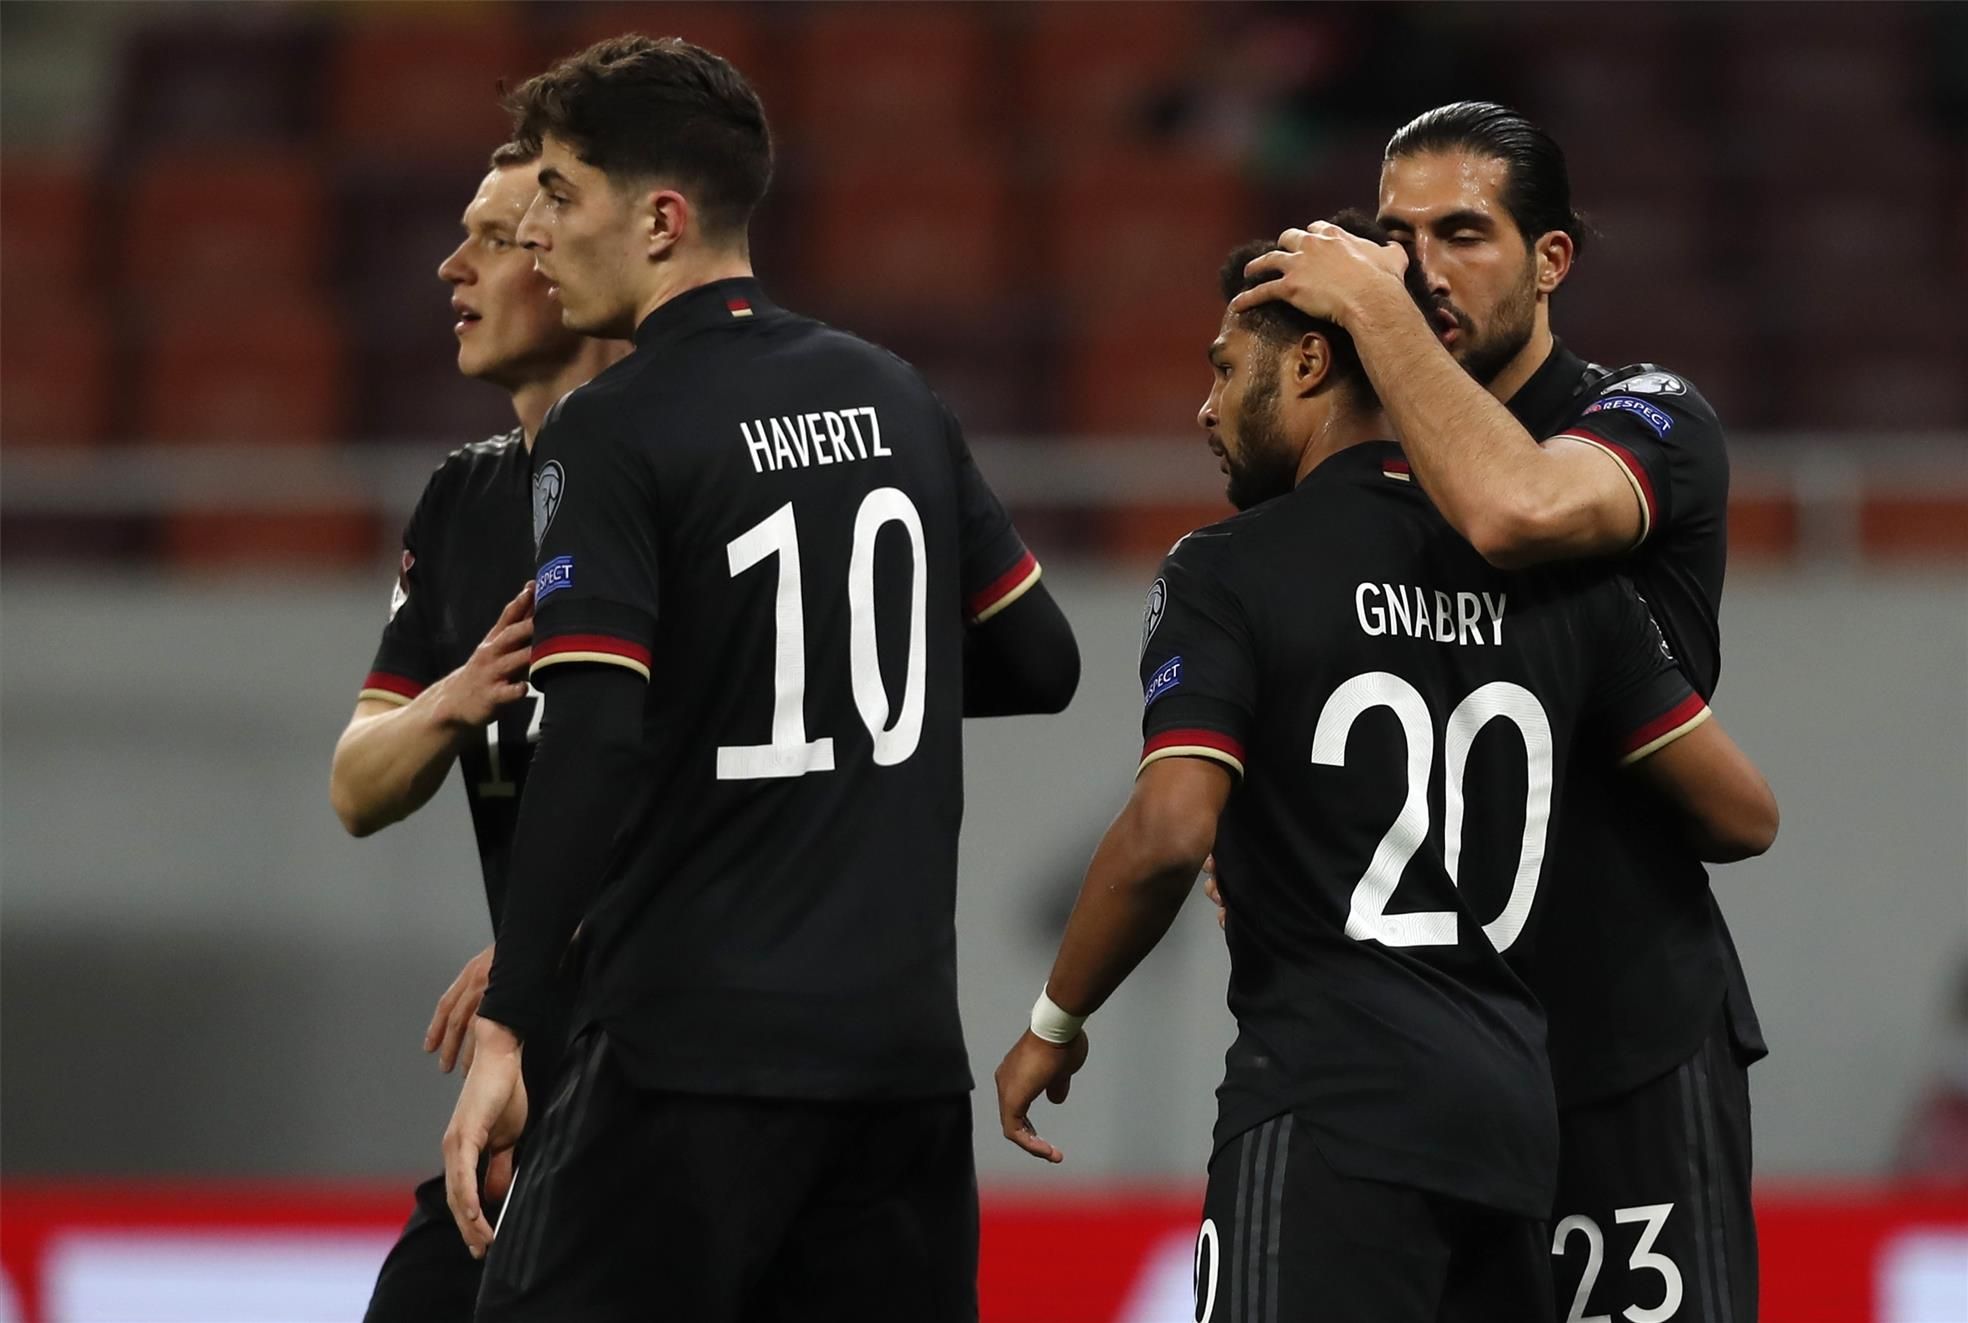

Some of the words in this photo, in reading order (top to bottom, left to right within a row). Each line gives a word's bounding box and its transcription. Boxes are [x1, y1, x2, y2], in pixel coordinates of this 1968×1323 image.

[740, 404, 893, 475] HAVERTZ
[1602, 399, 1672, 431] RESPECT
[716, 487, 928, 780] 10
[1355, 582, 1505, 646] GNABRY
[1310, 671, 1554, 954] 20
[1551, 1202, 1684, 1323] 23
